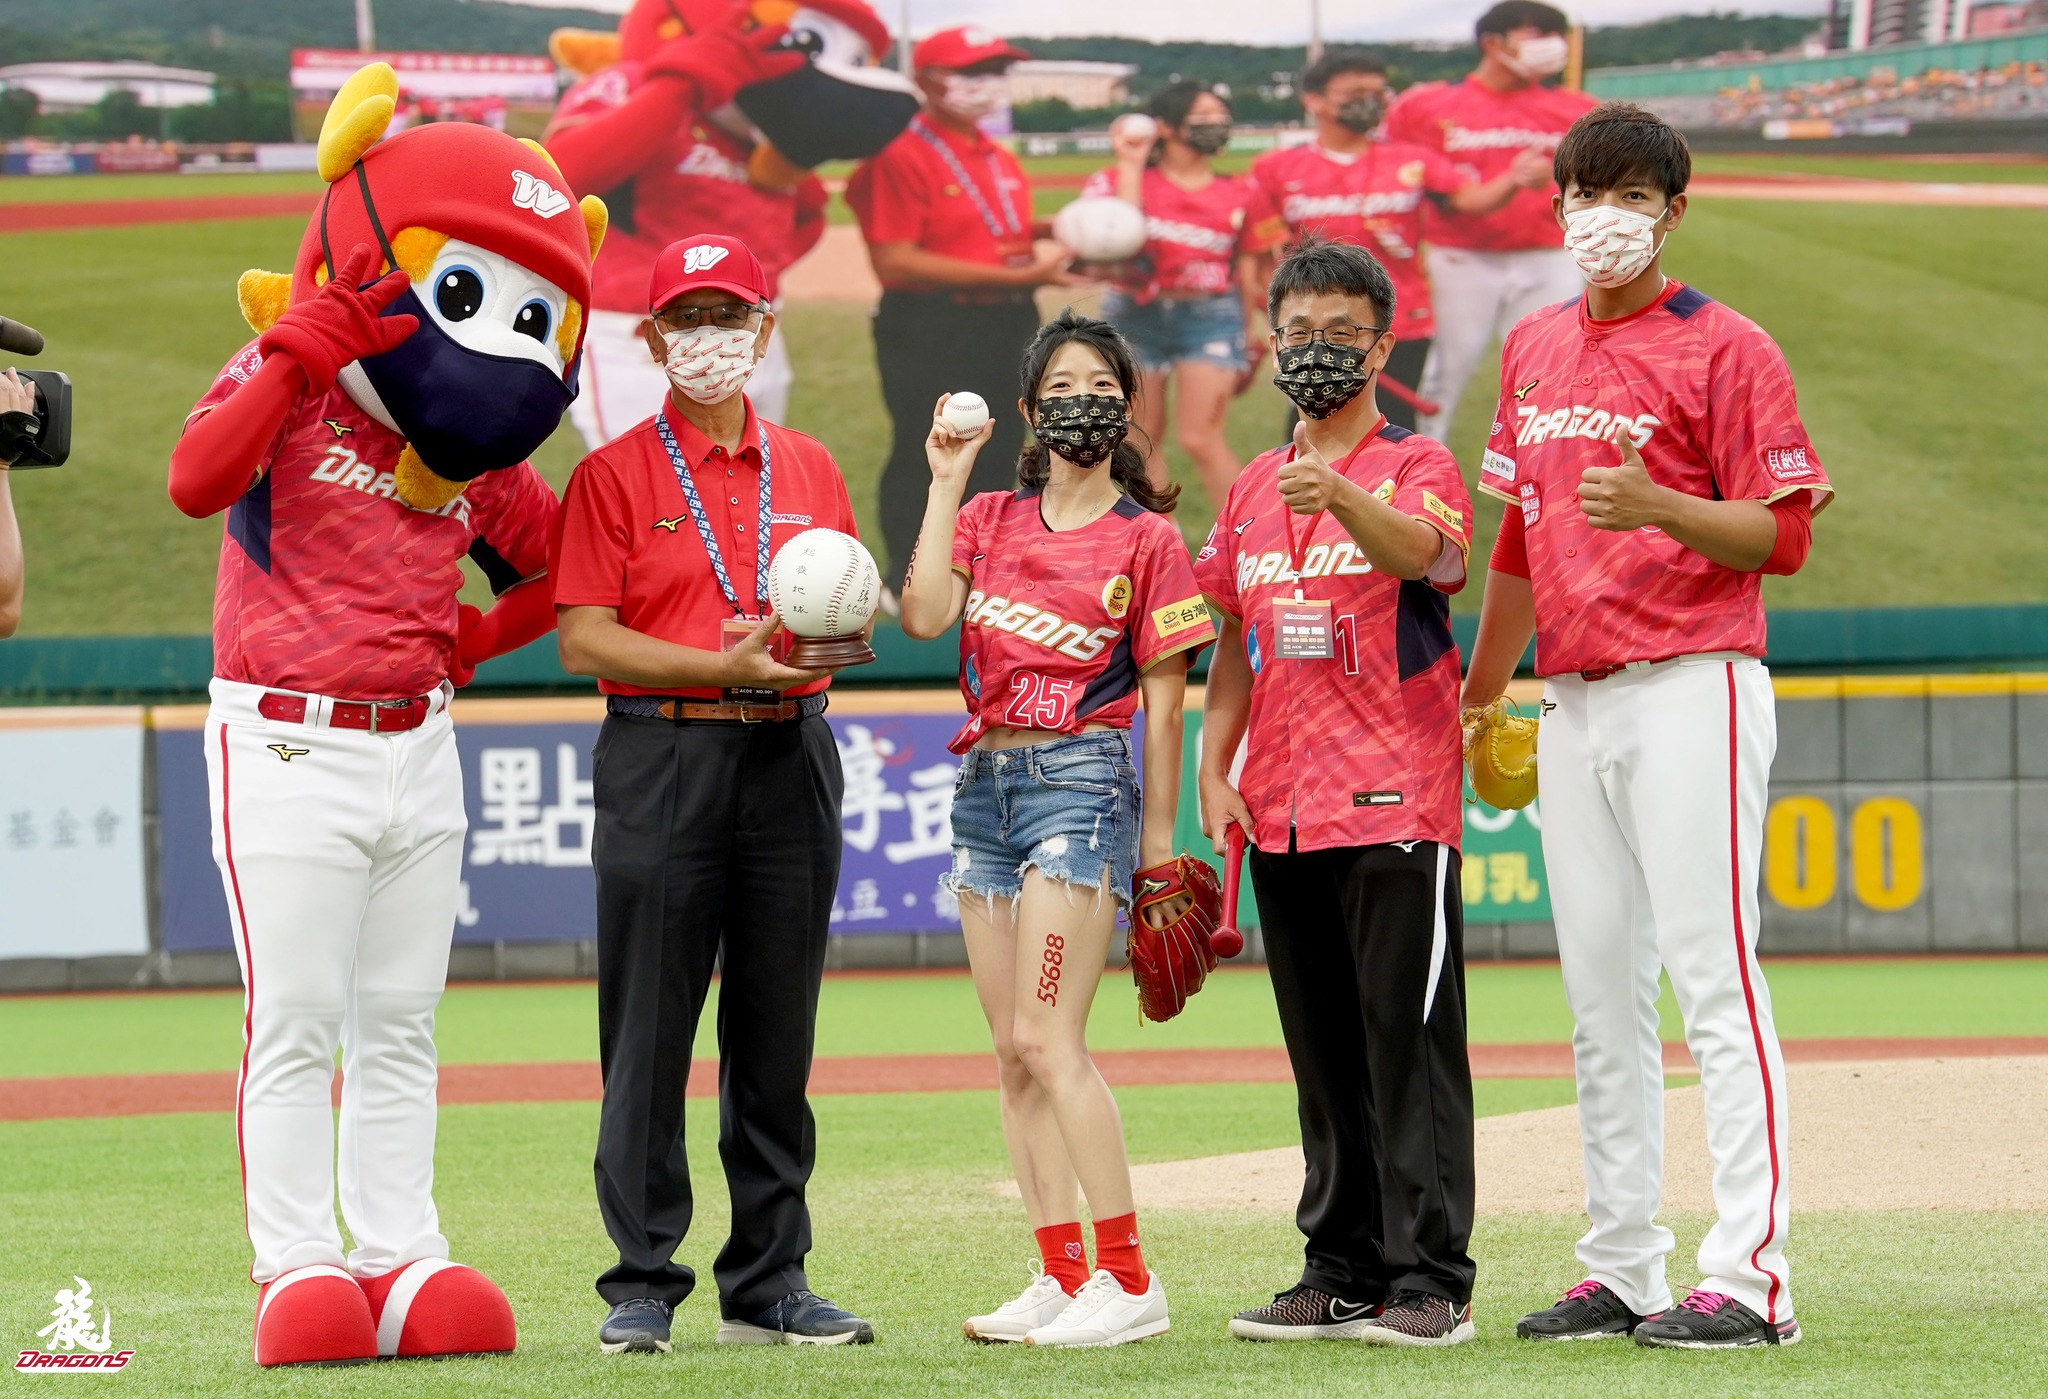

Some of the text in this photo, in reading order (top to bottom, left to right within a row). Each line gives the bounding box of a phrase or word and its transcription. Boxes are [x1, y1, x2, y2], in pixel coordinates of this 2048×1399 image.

[511, 169, 571, 219] W
[683, 244, 730, 275] W
[963, 589, 1121, 662] RAGONS
[1004, 669, 1073, 729] 25
[1764, 795, 1925, 912] 00
[1036, 933, 1065, 1007] 55688
